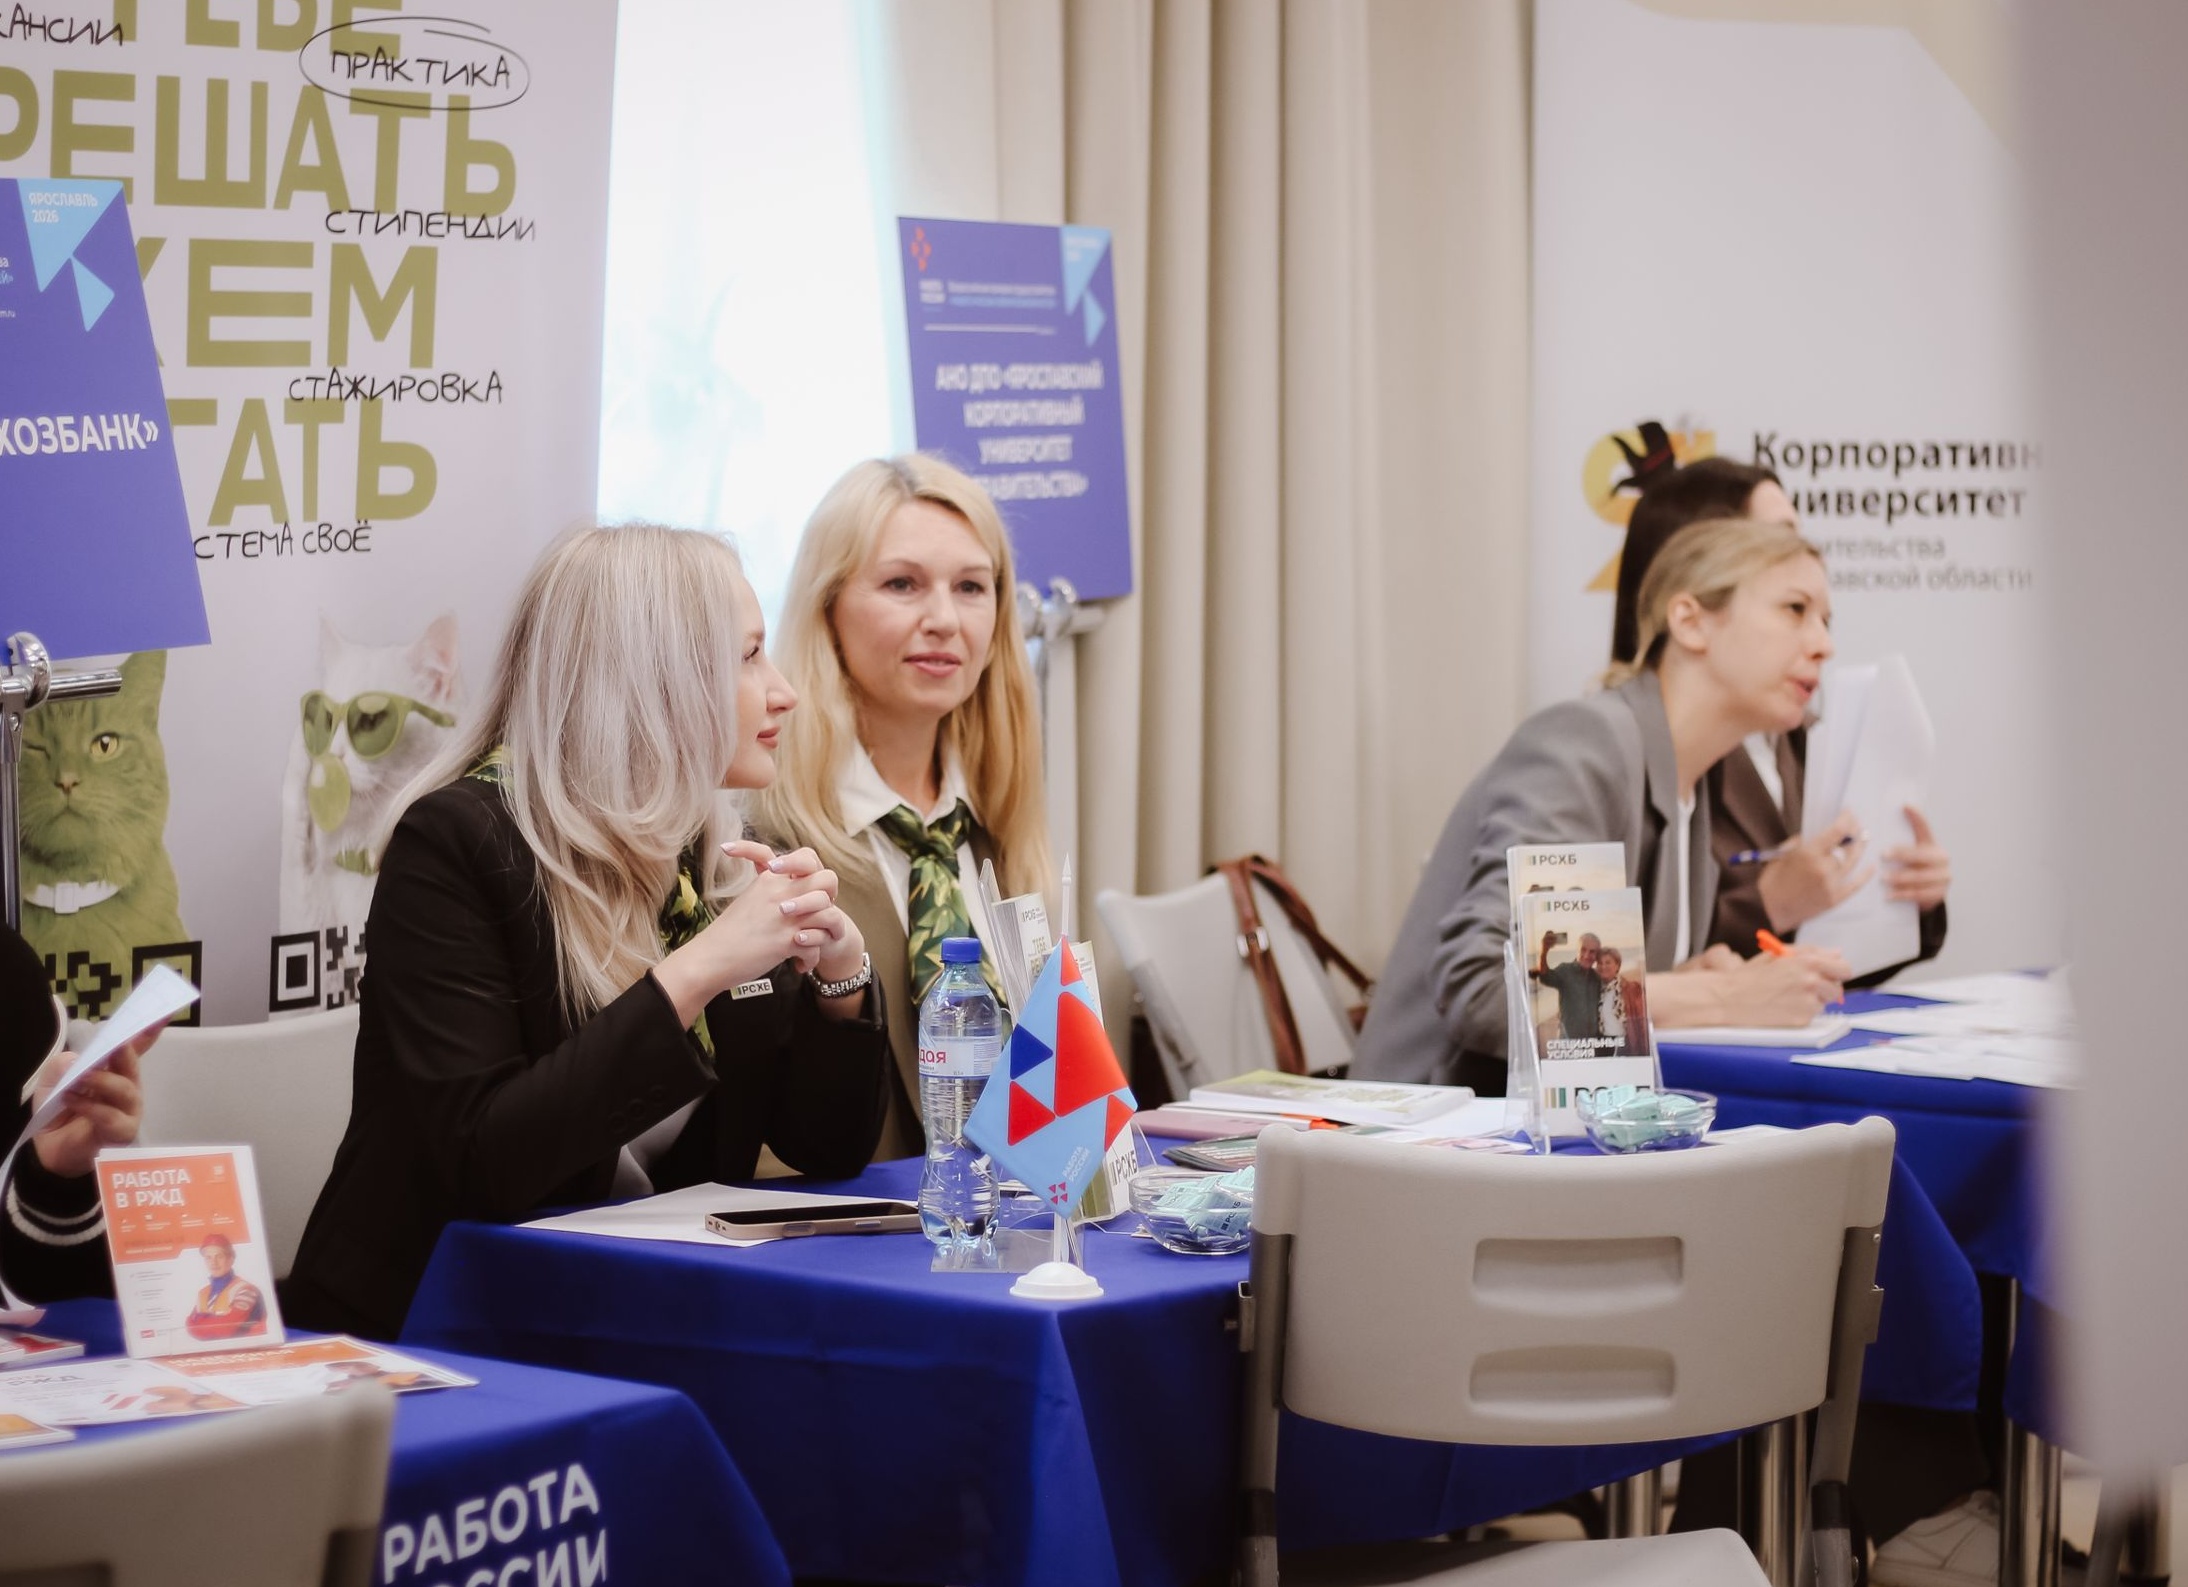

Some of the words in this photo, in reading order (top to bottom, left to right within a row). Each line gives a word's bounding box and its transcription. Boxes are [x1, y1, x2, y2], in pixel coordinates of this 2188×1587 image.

[331, 47, 511, 90] ПРАКТИКА
[28, 192, 98, 208] ЯРОСЛАВЛЬ
[31, 209, 60, 223] 2026
[325, 210, 535, 242] СТИПЕНДИИ
[289, 366, 502, 403] СТАЖИРОВКА
[194, 522, 293, 559] СТЕМА
[303, 519, 372, 555] СВОЁ
[1539, 853, 1577, 866] РСХБ
[1553, 900, 1590, 912] РСХБ
[112, 1168, 191, 1189] РАБОТА
[115, 1192, 129, 1208] В
[135, 1187, 185, 1207] РЖД
[383, 1463, 600, 1585] РАБОТА
